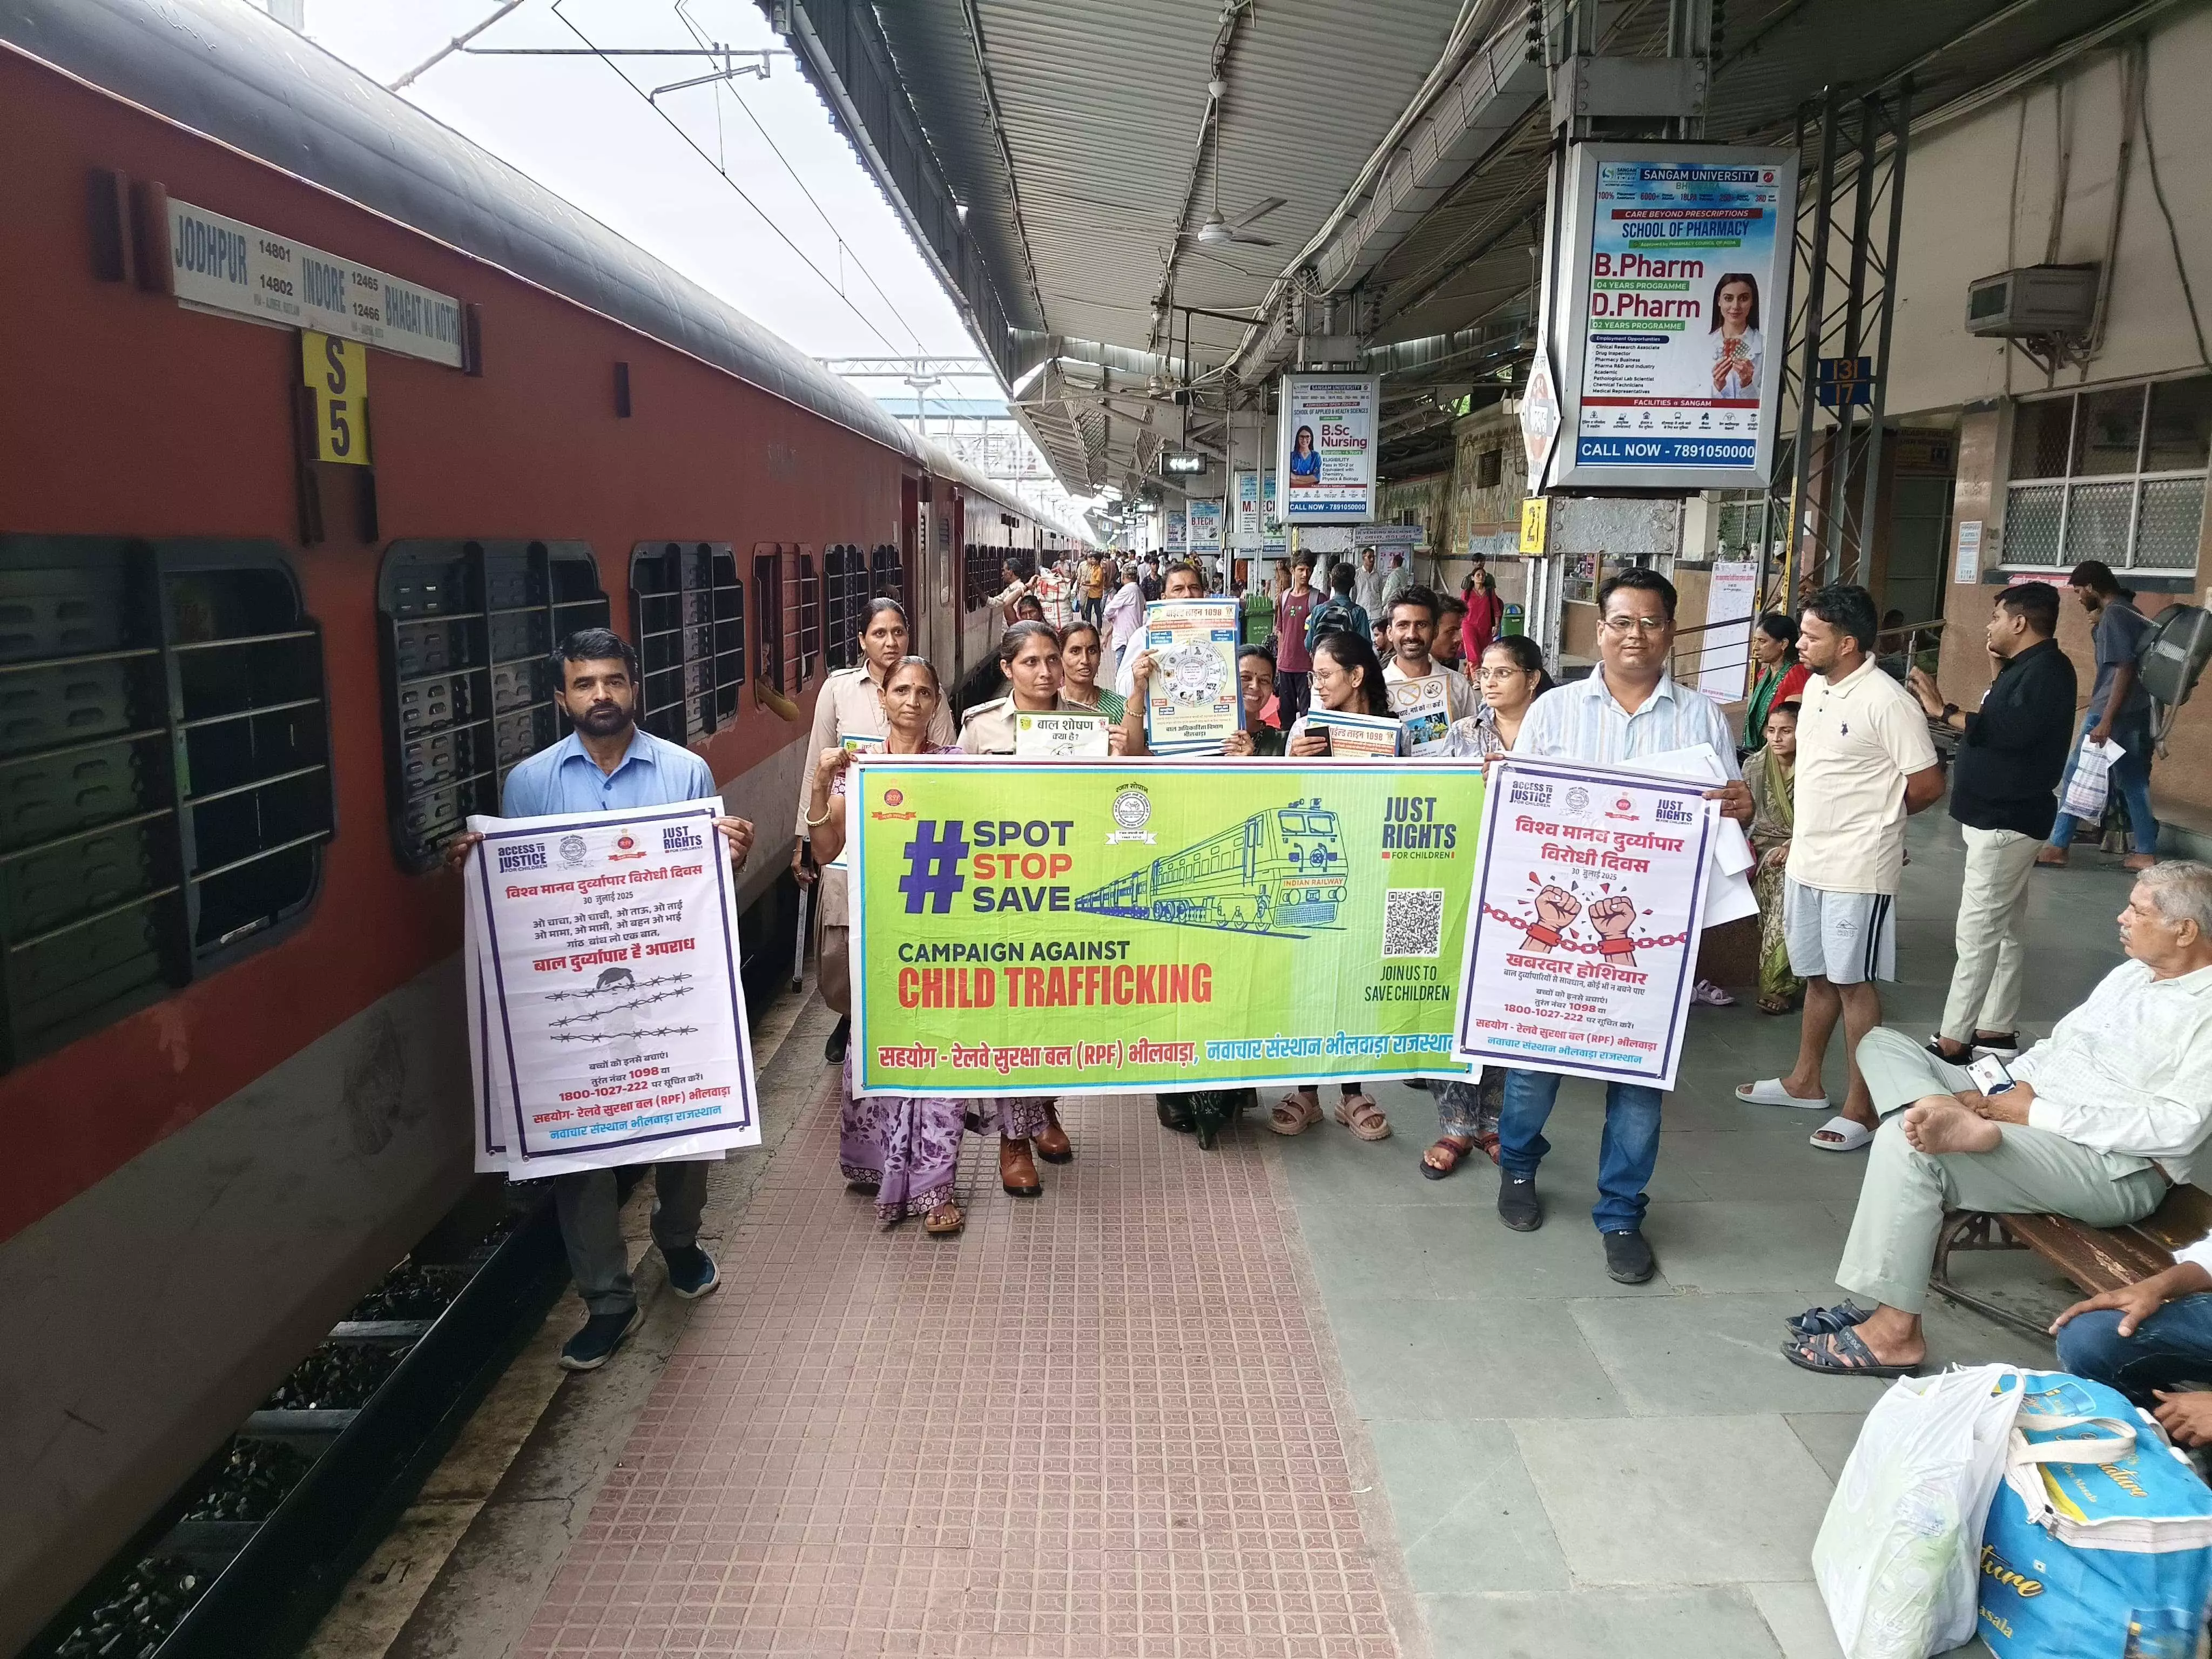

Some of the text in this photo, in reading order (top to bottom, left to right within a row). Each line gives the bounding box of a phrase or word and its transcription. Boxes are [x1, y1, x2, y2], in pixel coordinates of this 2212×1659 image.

[1644, 170, 1689, 180] SANGAM
[1692, 171, 1755, 181] UNIVERSITY
[1622, 221, 1749, 238] SCHOOL OF PHARMACY
[176, 215, 248, 285] JODHPUR
[259, 239, 291, 262] 14801
[1594, 253, 1703, 278] B.Pharm
[260, 274, 293, 296] 14802
[302, 257, 346, 314] INDORE
[352, 271, 379, 291] 12465
[353, 302, 379, 321] 12466
[385, 285, 460, 346] BHAGAT KI KOTHI
[1591, 293, 1700, 318] D.Pharm
[326, 336, 346, 395] S
[1833, 359, 1858, 380] 131
[1836, 383, 1854, 404] 17
[329, 399, 350, 456] 5
[1321, 424, 1350, 436] B.Sc
[1321, 436, 1367, 449] Nursing
[1582, 443, 1621, 456] CALL
[1624, 443, 1661, 457] NOW
[1674, 444, 1755, 458] 7891050000
[1191, 517, 1213, 525] B.TECH
[1037, 718, 1094, 730] बाल शोषण
[1366, 732, 1382, 741] 1098
[1384, 797, 1437, 822] JUST
[1656, 809, 1692, 821] RIGHTS
[1657, 799, 1683, 811] JUST
[663, 826, 689, 839] JUST
[664, 834, 702, 849] RIGHTS
[973, 820, 1074, 847] SPOT
[1382, 824, 1456, 849] RIGHTS
[1515, 815, 1684, 853] विश्व मानव दुर्व्यापार
[500, 853, 547, 873] JUSTICE
[973, 853, 1073, 880] STOP
[1541, 842, 1650, 873] विरोधी दिवस
[505, 864, 703, 899] विश्व मानव दुर्व्यापार विरोधी दिवस
[1283, 878, 1343, 887] INDIAN RAILWAY
[596, 892, 616, 905] जुलाई
[617, 892, 633, 901] 2025
[973, 886, 1070, 913] SAVE
[532, 938, 695, 972] बाल दुर्व्यापार है अपराध
[898, 940, 1130, 963] CAMPAIGN AGAINST
[1380, 966, 1437, 981] JOIN US TO
[1506, 953, 1648, 985] खबरदार होशियार
[898, 963, 1212, 1009] CHILD TRAFFICKING
[1365, 985, 1449, 1001] SAVE CHILDREN
[1504, 1003, 1583, 1022] 1800-1027-222
[1476, 1018, 1508, 1031] सहयोग
[1516, 1023, 1537, 1035] रेलवे
[1540, 1027, 1567, 1040] सुरक्षा
[1569, 1033, 1583, 1042] बल
[1587, 1033, 1615, 1046] (RPF)
[1617, 1036, 1658, 1051] भीलवाड़ा
[879, 1042, 937, 1069] सहयोग
[952, 1042, 990, 1068] रेलवे
[994, 1046, 1042, 1074] सुरक्षा
[1044, 1046, 1073, 1066] बल
[1077, 1040, 1122, 1070] (RPF)
[1207, 1039, 1262, 1061] नवाचार
[1266, 1033, 1322, 1058] संस्थान
[1325, 1031, 1390, 1058] भीलवाड़ा
[1487, 1036, 1642, 1064] नवाचार संस्थान भीलवाड़ा राजस्थान
[558, 1081, 649, 1102] 1800-1027-222
[664, 1076, 686, 1088] सूचित
[549, 1105, 722, 1140] नवाचार संस्थान भीलवाड़ा राजस्थान
